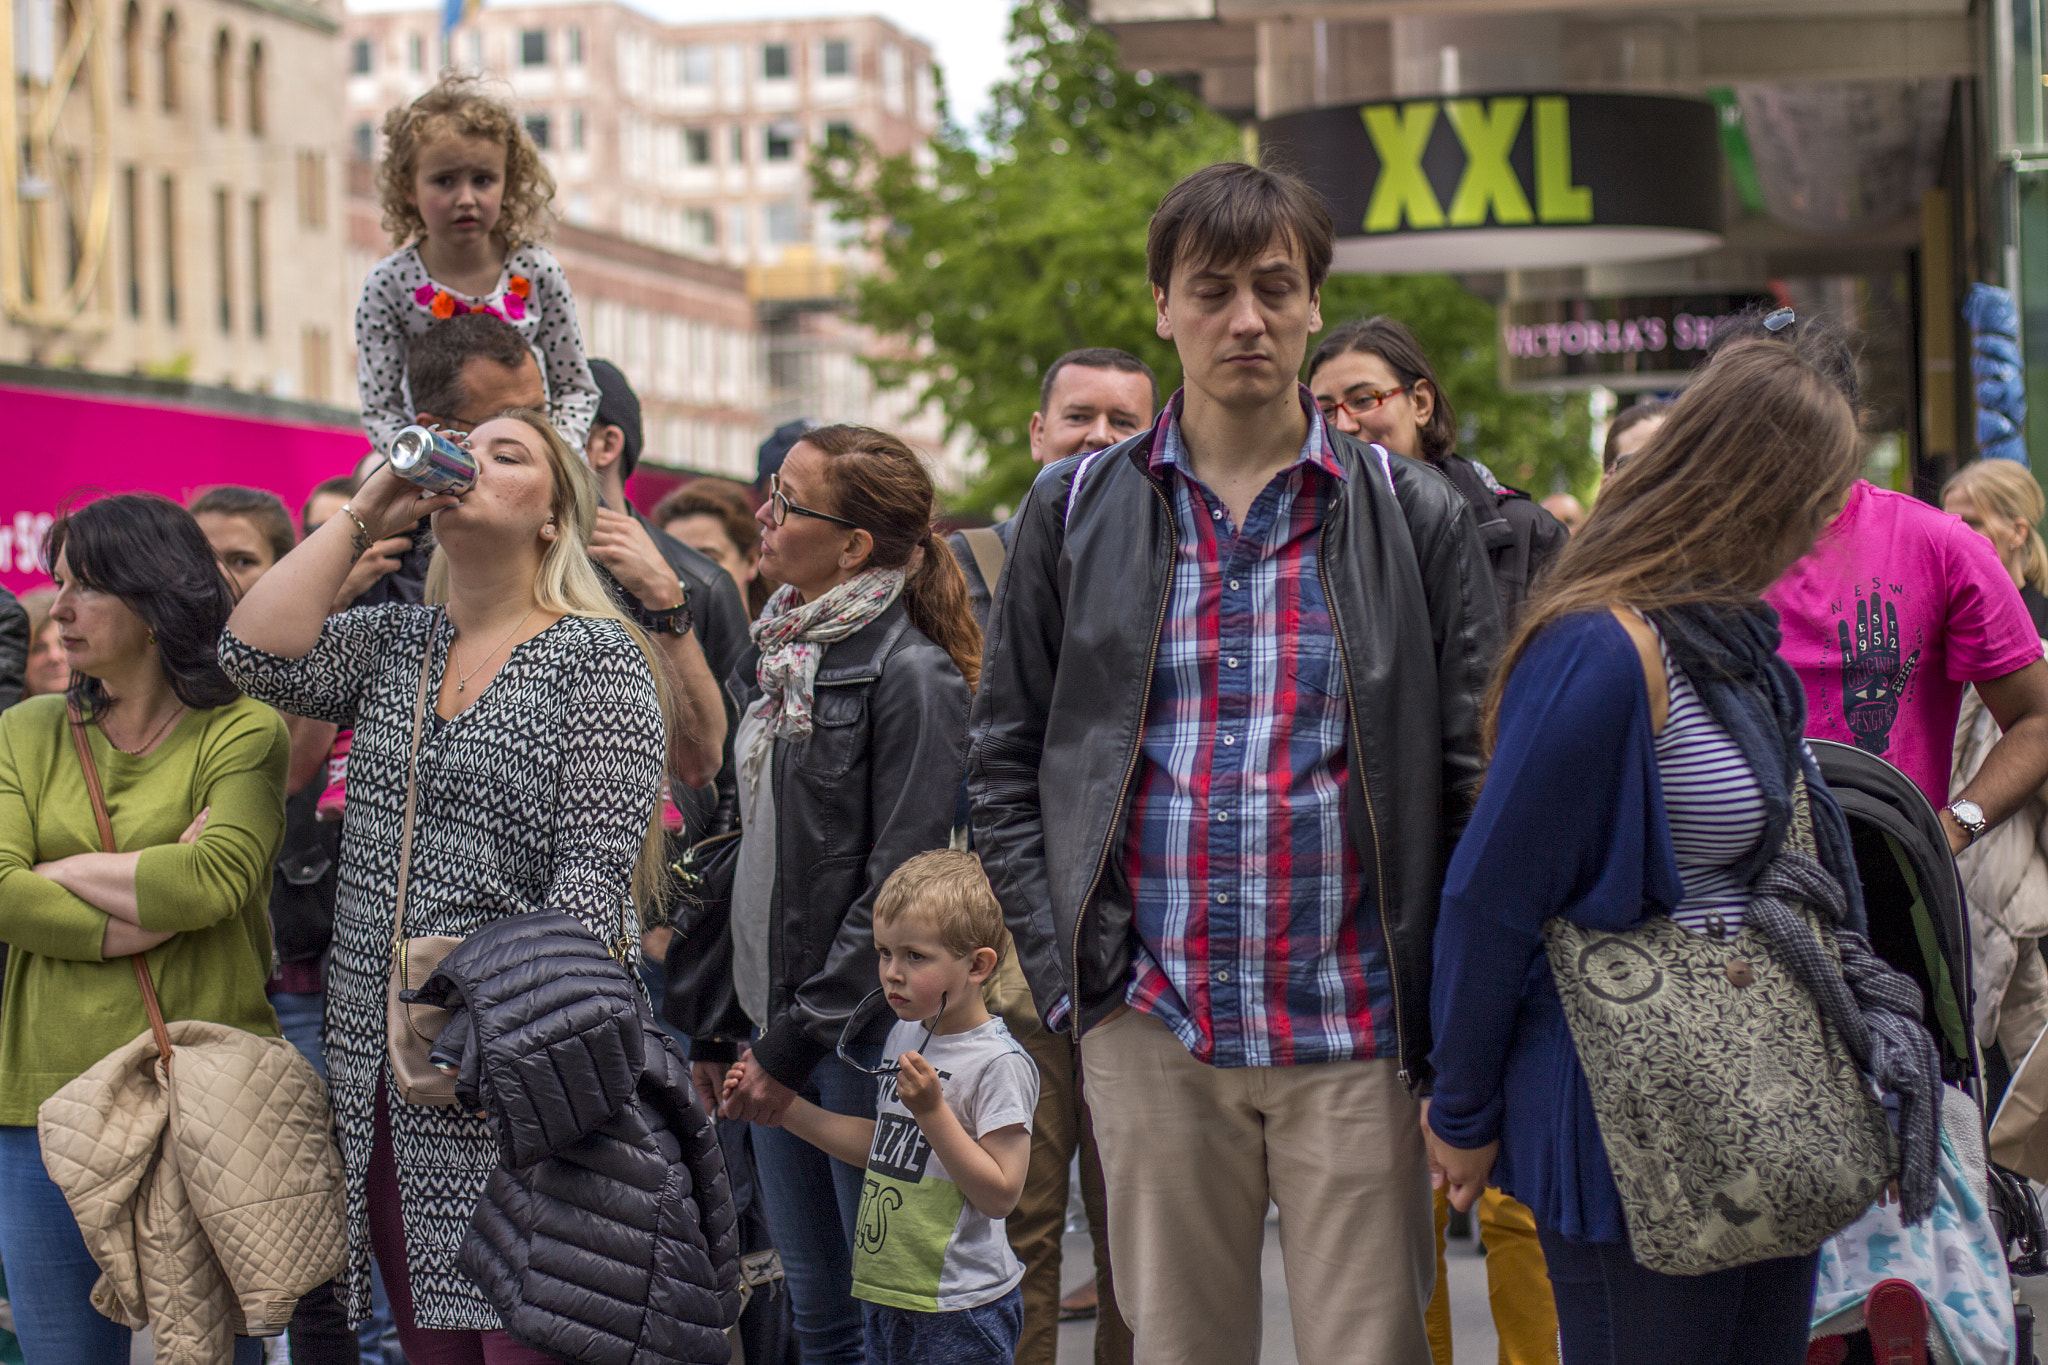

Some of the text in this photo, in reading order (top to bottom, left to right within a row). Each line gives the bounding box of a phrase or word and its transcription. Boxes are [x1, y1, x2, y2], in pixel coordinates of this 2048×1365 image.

[1361, 96, 1594, 233] XXL
[1504, 315, 1667, 358] VICTORIA'S
[1831, 576, 1903, 615] N E S W
[1847, 656, 1896, 688] ORIGINAL
[870, 1114, 926, 1173] LIKE
